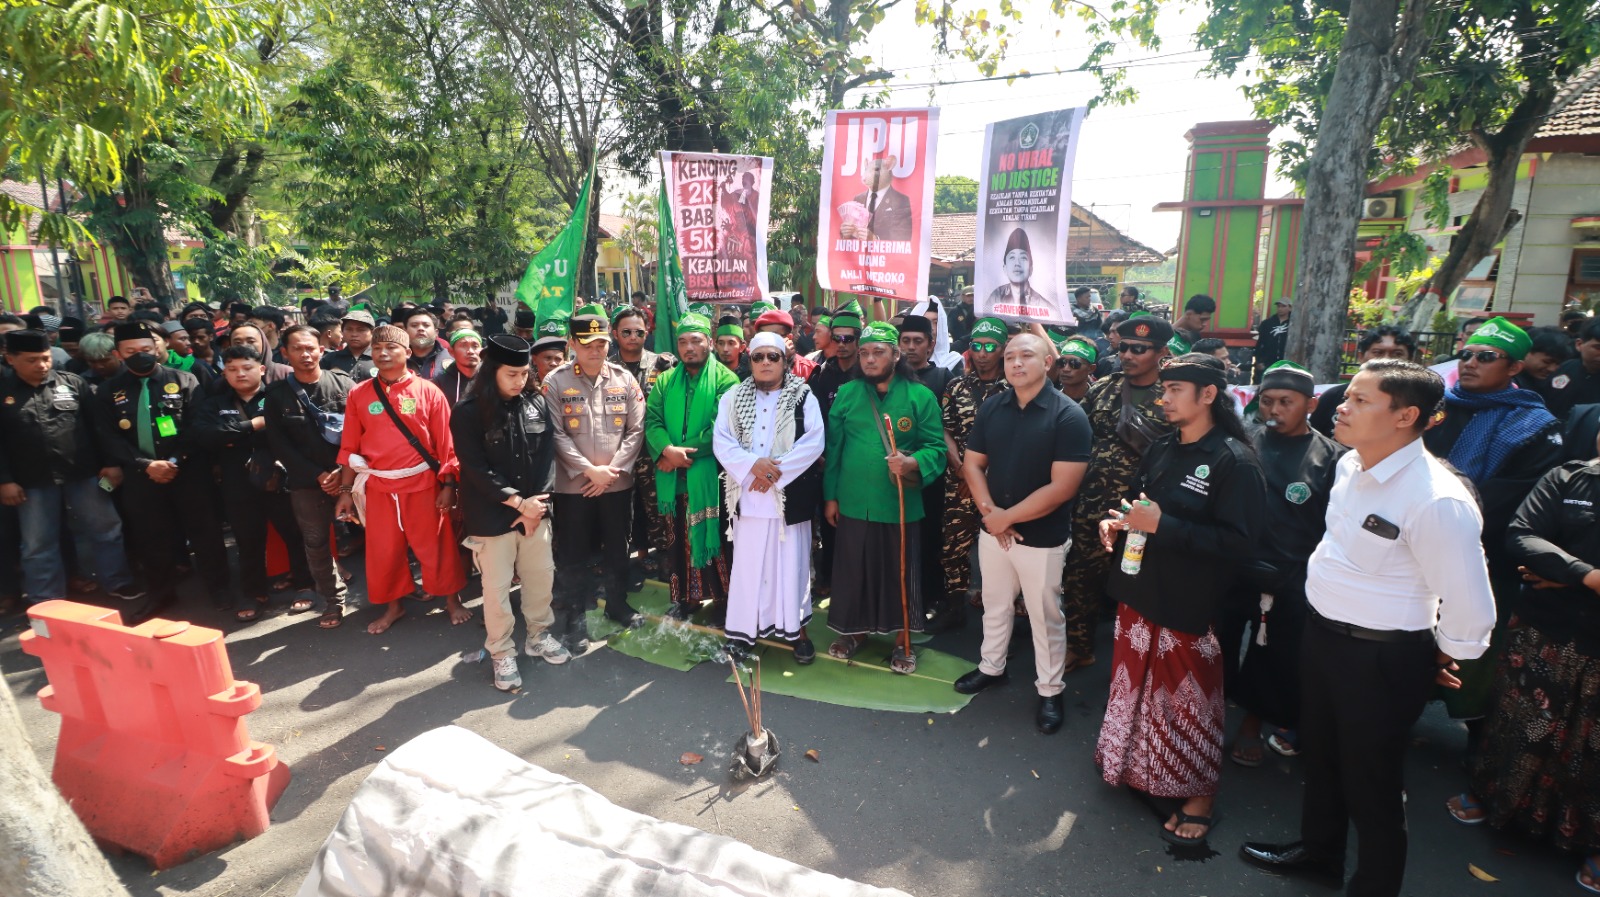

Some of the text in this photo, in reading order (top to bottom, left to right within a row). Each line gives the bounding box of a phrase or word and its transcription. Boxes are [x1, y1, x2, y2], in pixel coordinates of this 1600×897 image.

[840, 116, 919, 178] JPU
[998, 148, 1053, 172] NO VIRAL
[678, 159, 738, 182] KENCING
[991, 167, 1059, 191] NO JUSTICE
[680, 208, 714, 228] BAB
[835, 239, 912, 254] JURU PENERIMA
[688, 258, 748, 275] KEADILAN
[858, 254, 886, 267] UANG
[689, 274, 714, 289] BISA
